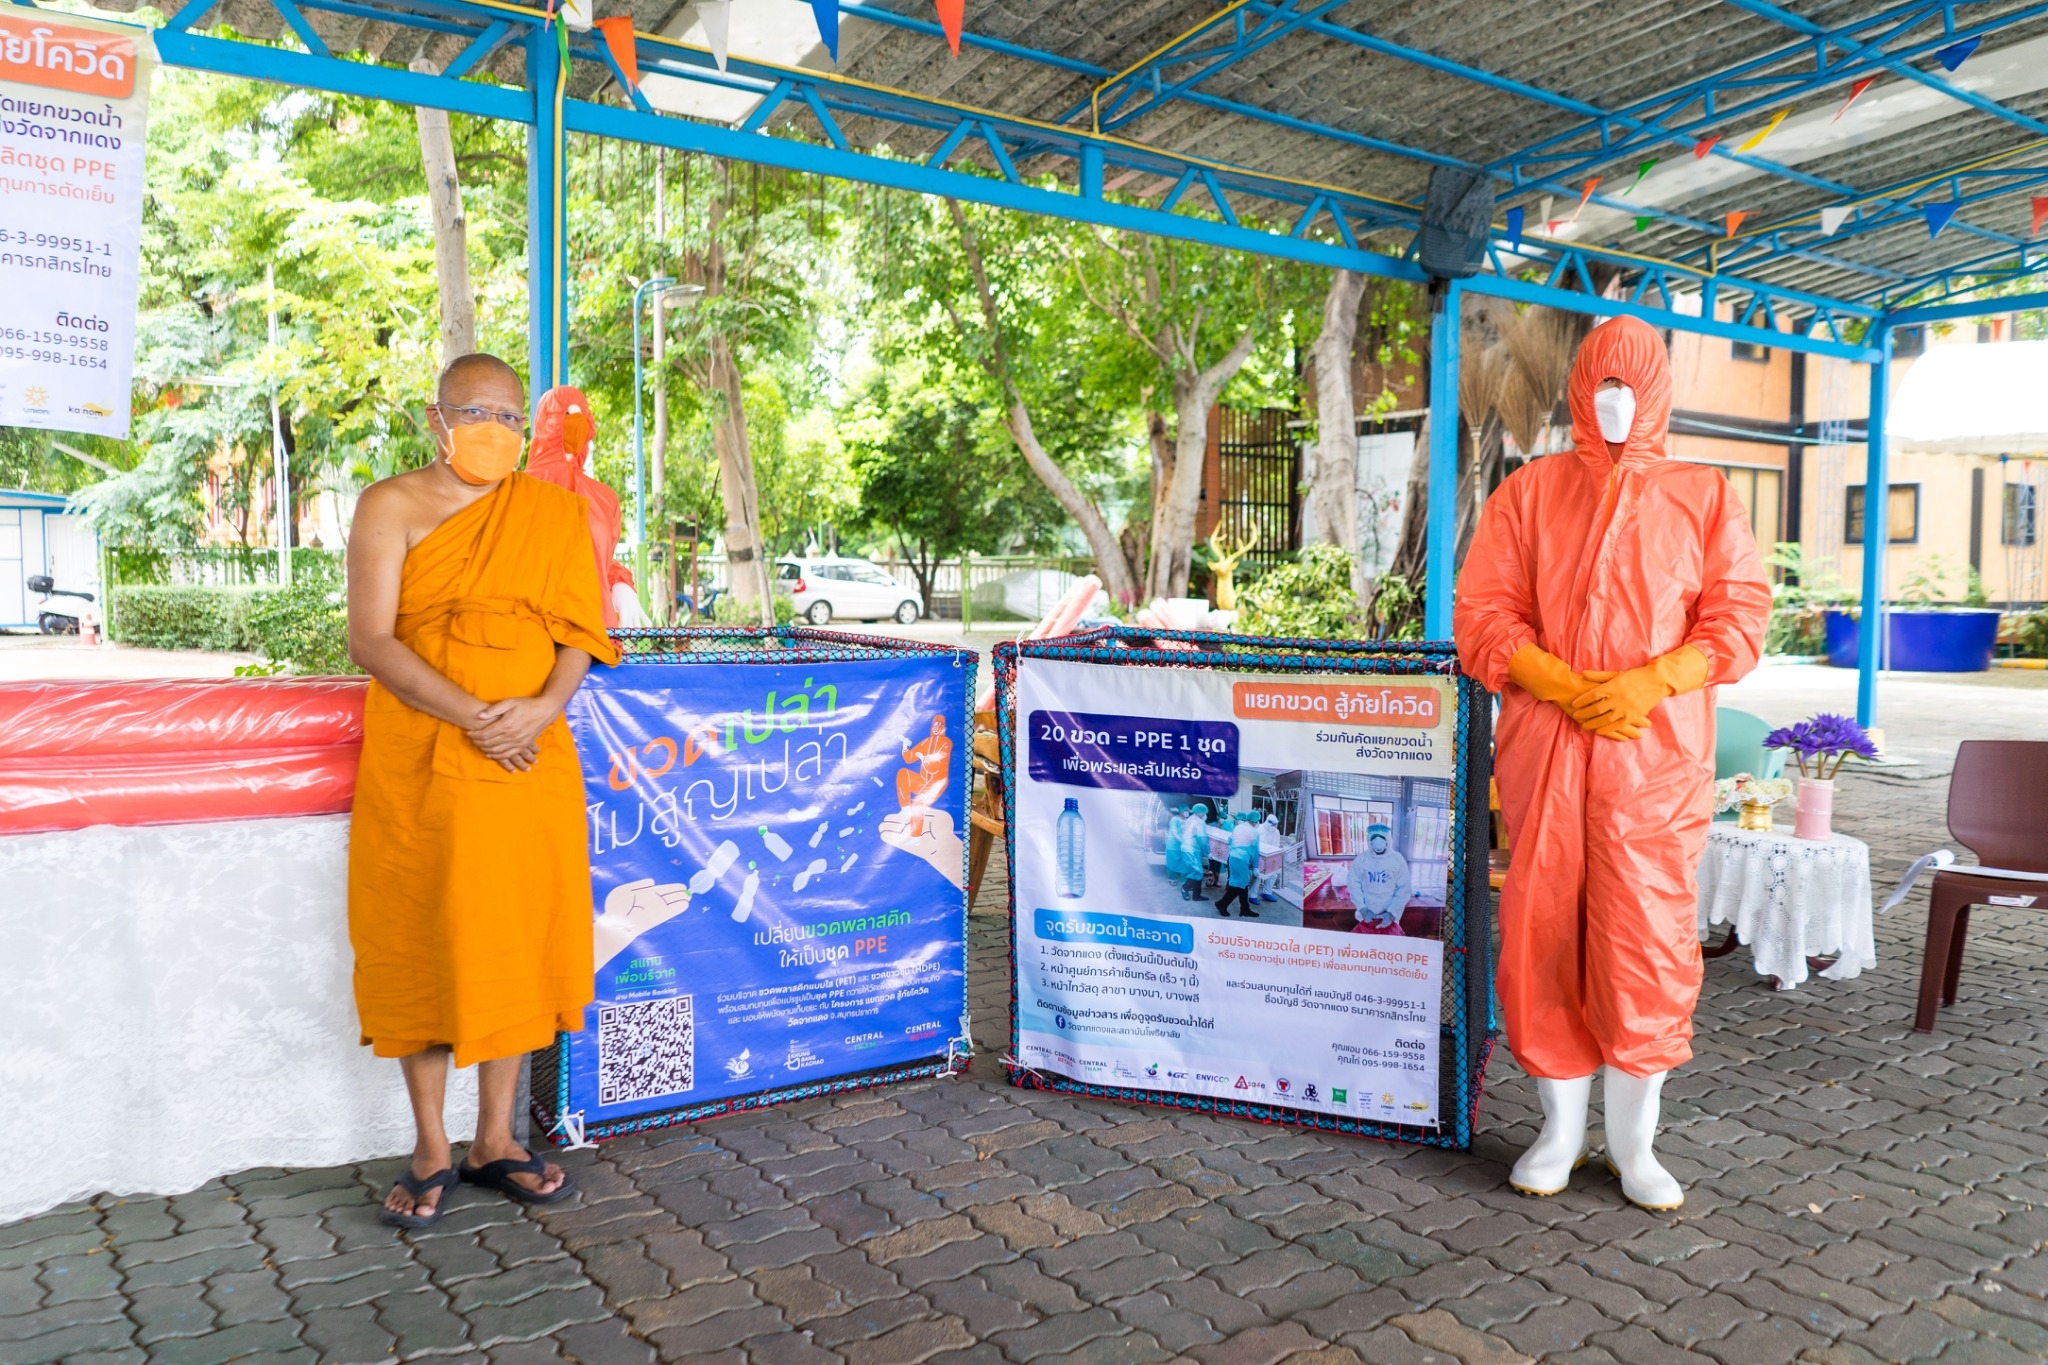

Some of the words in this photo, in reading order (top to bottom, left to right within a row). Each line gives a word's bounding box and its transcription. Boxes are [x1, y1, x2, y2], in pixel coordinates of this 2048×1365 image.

[0, 27, 125, 81] ัยโควิด
[0, 94, 123, 129] ดแยกขวดน้ำ
[0, 114, 122, 150] งวัดจากแดง
[73, 157, 116, 180] PPE
[0, 229, 112, 256] 6-3-99951-1
[56, 312, 109, 333] ติดต่อ
[1245, 692, 1328, 712] แยกขวด
[1335, 689, 1433, 720] สู้ภัยโควิด
[608, 676, 837, 792] ขวดเปล่า
[1041, 724, 1065, 742] 20
[1070, 729, 1110, 746] ขวด
[1117, 735, 1128, 744] =
[1134, 730, 1173, 749] PPE
[1180, 734, 1191, 751] 1
[1198, 738, 1226, 759] ชุด
[1316, 730, 1433, 748] ร่วมกันคัดแยกขวดน้ำ
[1356, 746, 1432, 762] ส่งวัดจากแดง
[1063, 752, 1201, 779] เพื่อพระและสัปเหร่อ
[1045, 917, 1182, 945] จุดรับขวดน้ำสะอาด
[855, 935, 887, 957] PPE
[1040, 945, 1049, 955] 1.
[1051, 946, 1102, 960] วัดจากแดง
[1208, 932, 1300, 953] ร่วมบริจาคขวดใส
[1303, 944, 1335, 957] (PET)
[1337, 943, 1403, 965] เพื่อผลิตชุด
[1406, 952, 1429, 966] PPE
[1040, 963, 1049, 972] 2.
[1218, 949, 1236, 960] หรือ
[1287, 957, 1321, 969] (HDPE)
[829, 989, 845, 999] PPE
[1041, 978, 1049, 988] 3.
[1101, 985, 1126, 995] สาขา
[1301, 998, 1349, 1013] วัดจากแดง
[1351, 1005, 1427, 1022] ธนาคารกสิกรไทย
[1355, 993, 1427, 1010] 046-3-99951-1
[905, 1020, 942, 1034] CENTRAL
[845, 1031, 884, 1045] CENTRAL
[1394, 1038, 1426, 1051] ติดต่อ
[1025, 1044, 1053, 1055] CENTRAL
[1054, 1050, 1076, 1063] CENTRAL
[1362, 1047, 1426, 1061] 066-159-9558
[1079, 1059, 1108, 1067] CENTRAL
[1362, 1058, 1425, 1072] 095-998-1654
